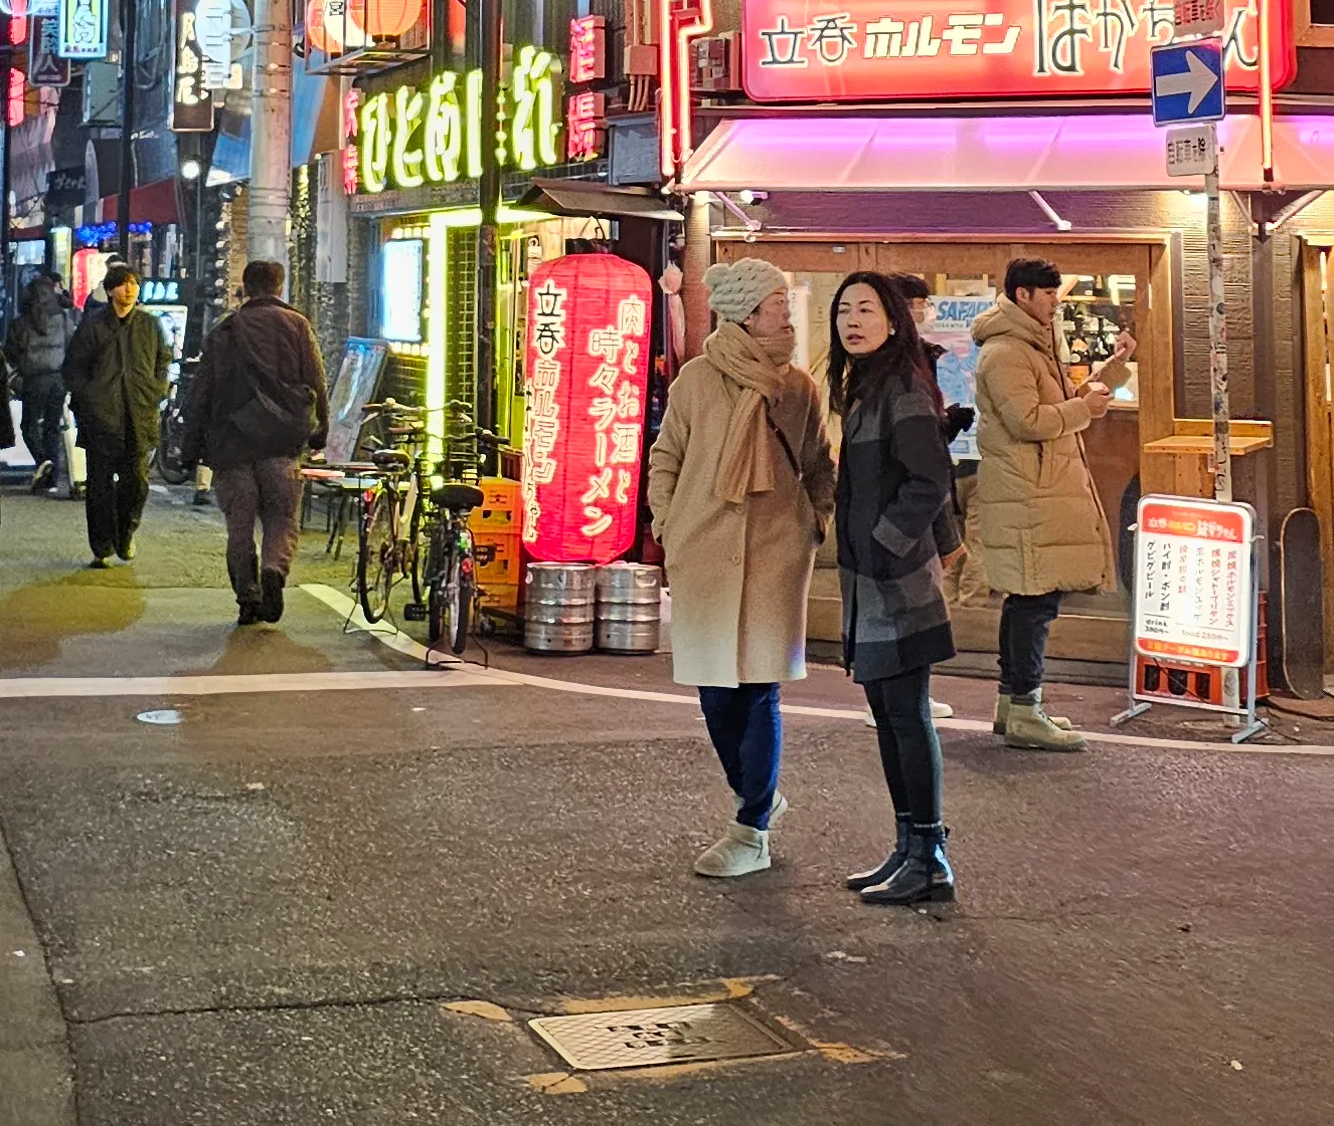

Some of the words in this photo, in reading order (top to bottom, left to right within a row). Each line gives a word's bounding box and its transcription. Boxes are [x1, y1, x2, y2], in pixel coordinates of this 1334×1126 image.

[864, 12, 1023, 60] ホルモン
[534, 279, 565, 354] 立呑
[580, 325, 624, 538] 時々ラーメン
[610, 294, 647, 505] 肉とお酒と
[1146, 619, 1168, 627] drink
